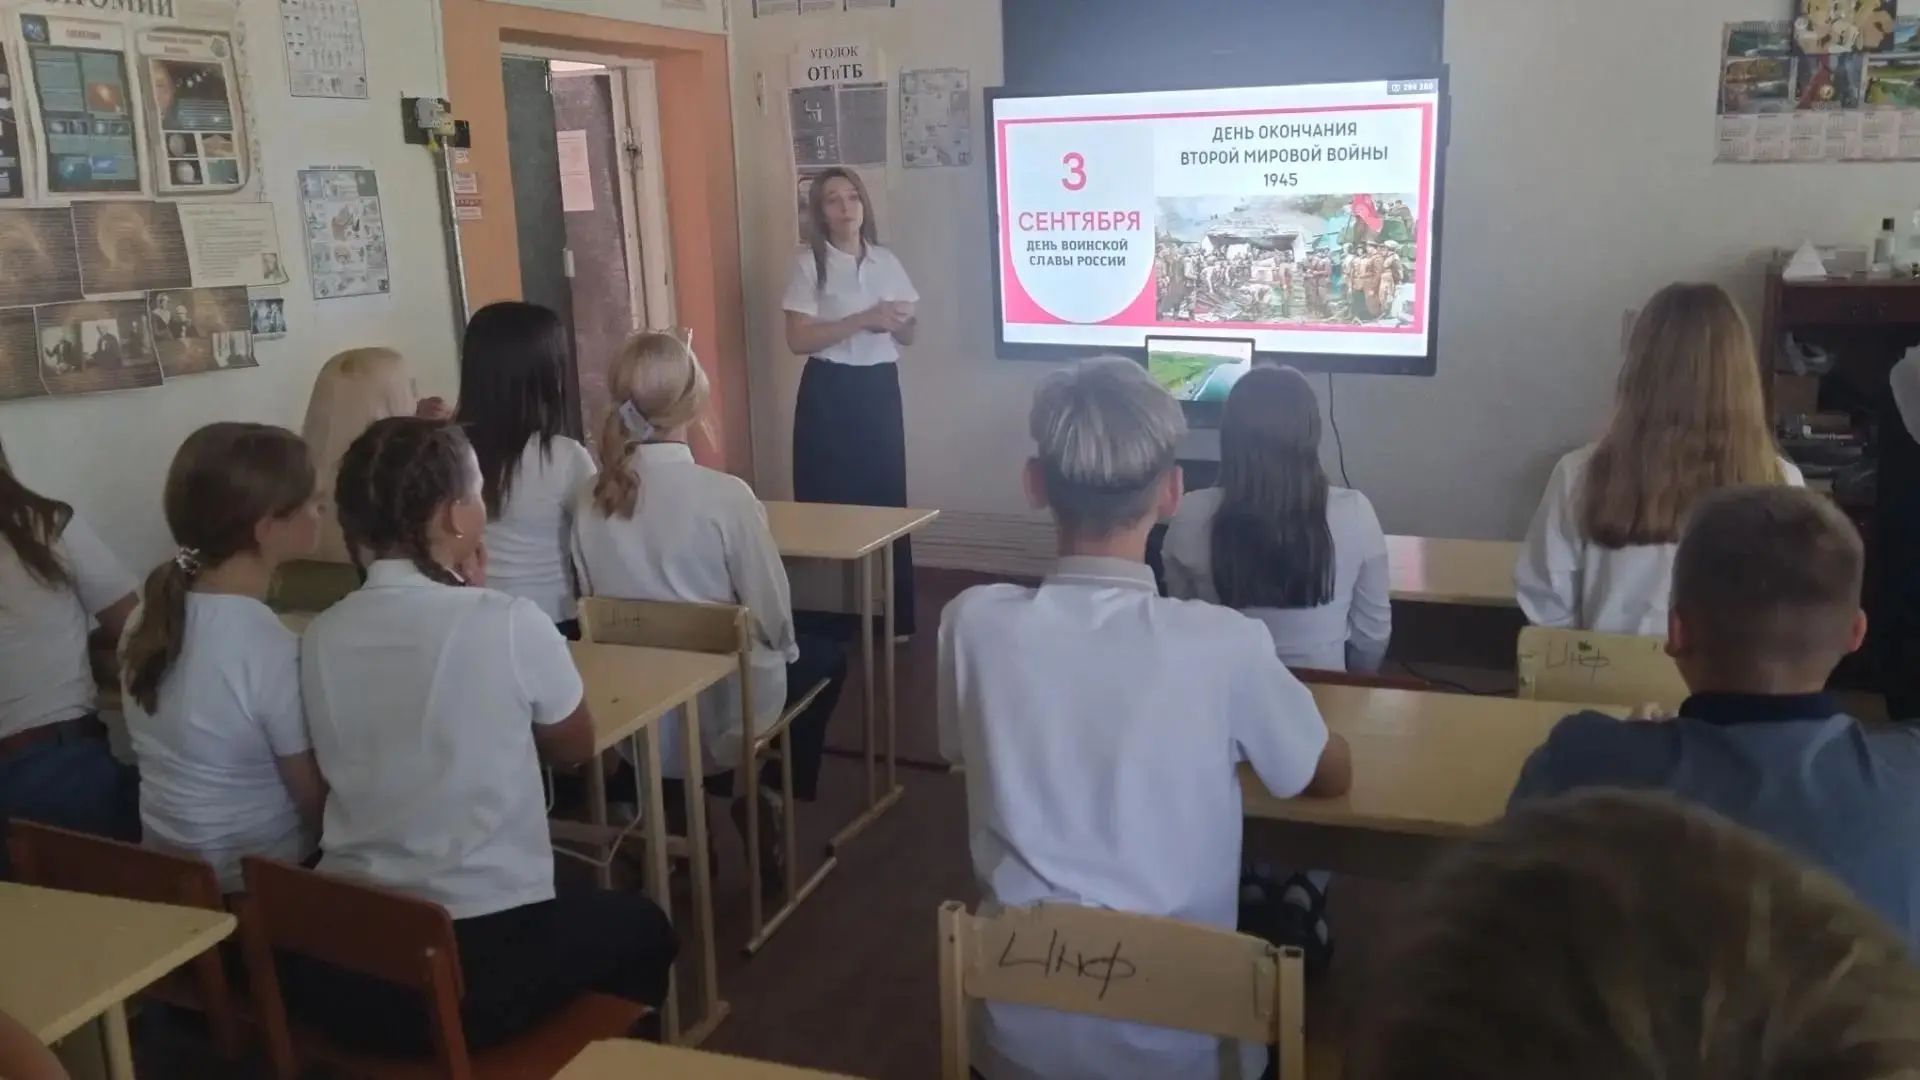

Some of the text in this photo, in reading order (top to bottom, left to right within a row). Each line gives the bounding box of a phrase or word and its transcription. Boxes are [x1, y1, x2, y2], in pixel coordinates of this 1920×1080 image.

[809, 45, 859, 60] УГОЛОК
[1212, 121, 1357, 143] ДЕНЬ ОКОНЧАНИЯ
[1181, 143, 1388, 165] ВТОРОЙ МИРОВОЙ ВОЙНЫ
[1061, 151, 1087, 191] 3
[1263, 172, 1298, 187] 1945
[1018, 211, 1141, 231] СЕНТЯБРЯ
[1026, 238, 1128, 252] ДЕНЬ ВОИНСКОЙ
[1029, 255, 1126, 266] СЛАВЫ РОССИИ
